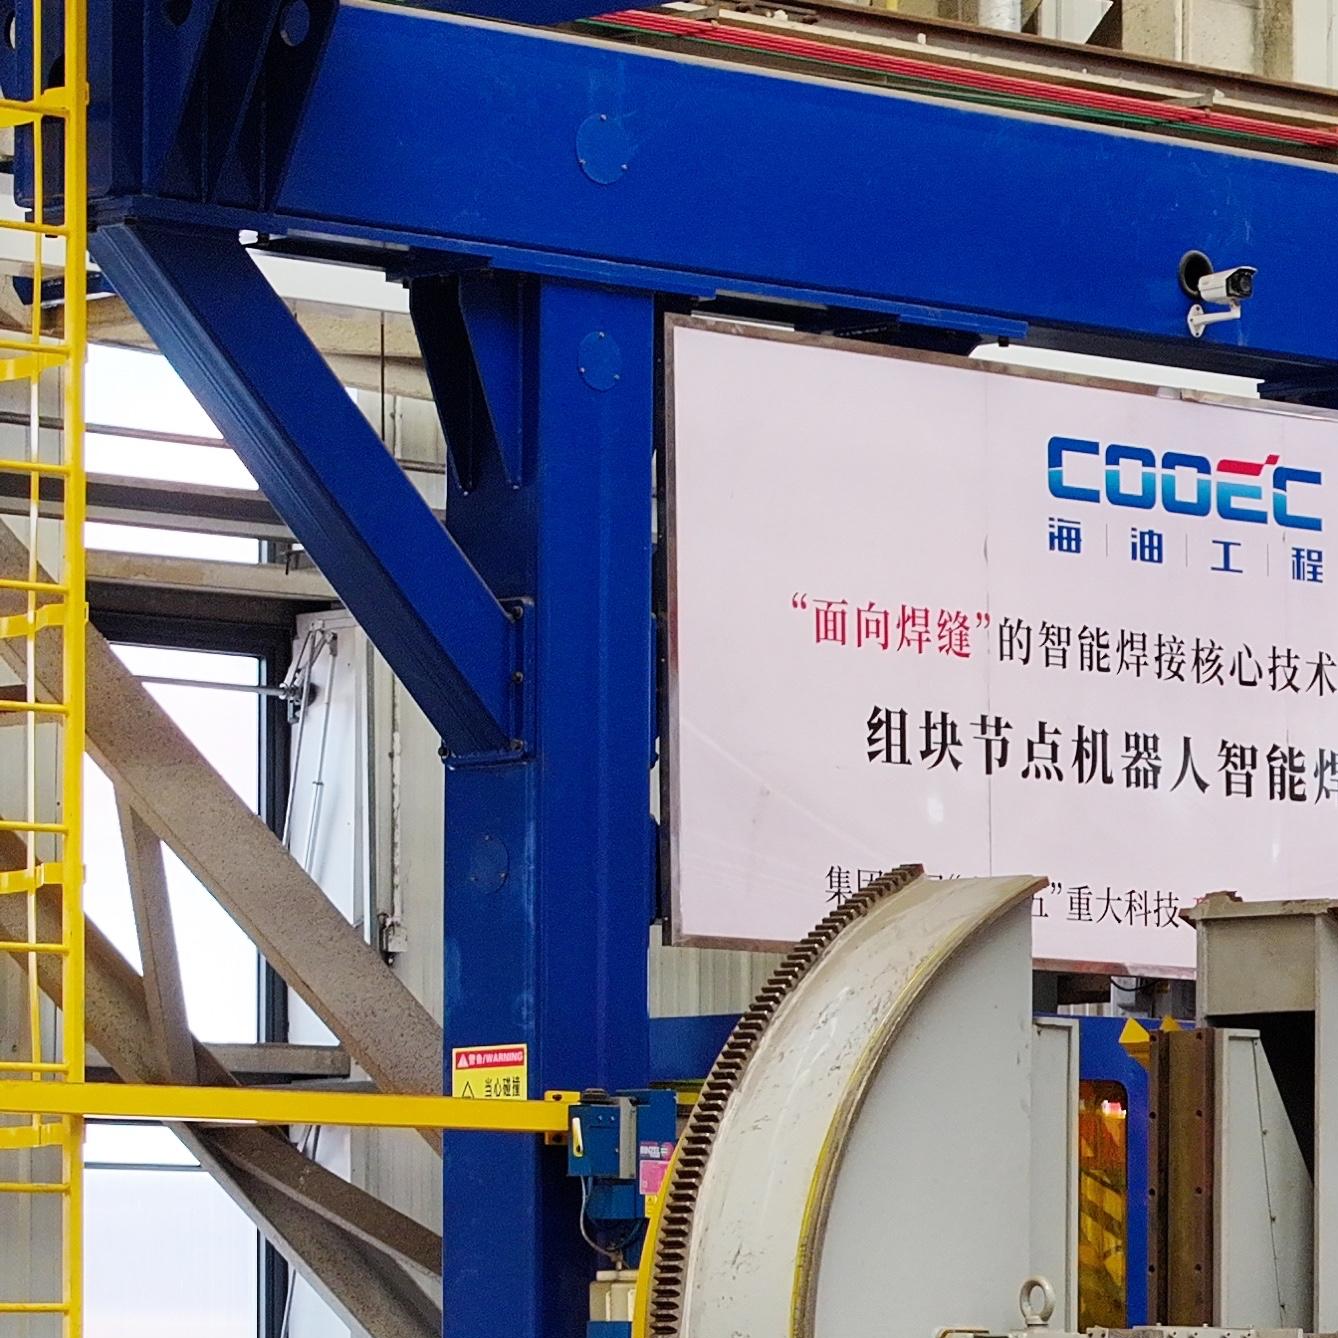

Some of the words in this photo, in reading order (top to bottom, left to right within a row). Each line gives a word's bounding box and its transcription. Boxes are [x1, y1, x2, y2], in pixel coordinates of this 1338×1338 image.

[1048, 436, 1322, 532] COOEC
[1049, 517, 1323, 583] 海油工程
